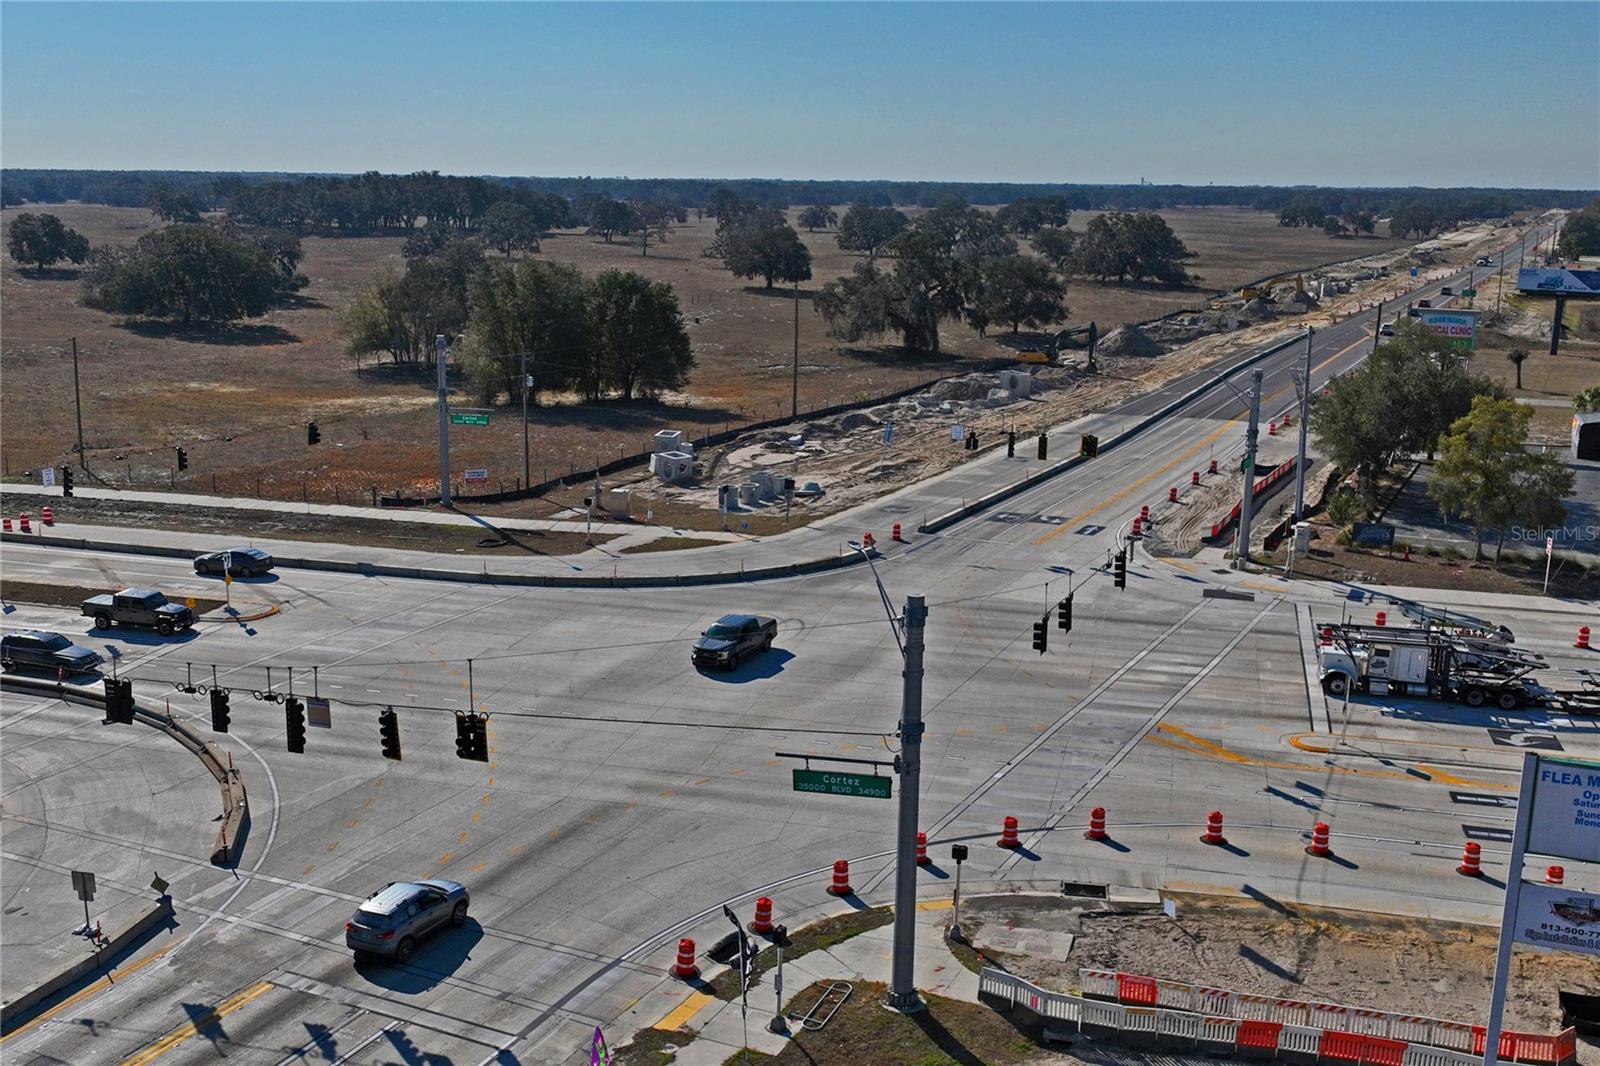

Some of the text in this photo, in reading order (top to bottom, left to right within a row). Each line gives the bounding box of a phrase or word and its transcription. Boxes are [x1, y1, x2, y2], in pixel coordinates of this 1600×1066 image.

[1451, 326, 1472, 336] CLINIC
[823, 774, 860, 786] Cortez
[1541, 770, 1583, 786] FLEA
[798, 782, 887, 796] 35000 BLVD 34900
[1583, 790, 1600, 803] Op
